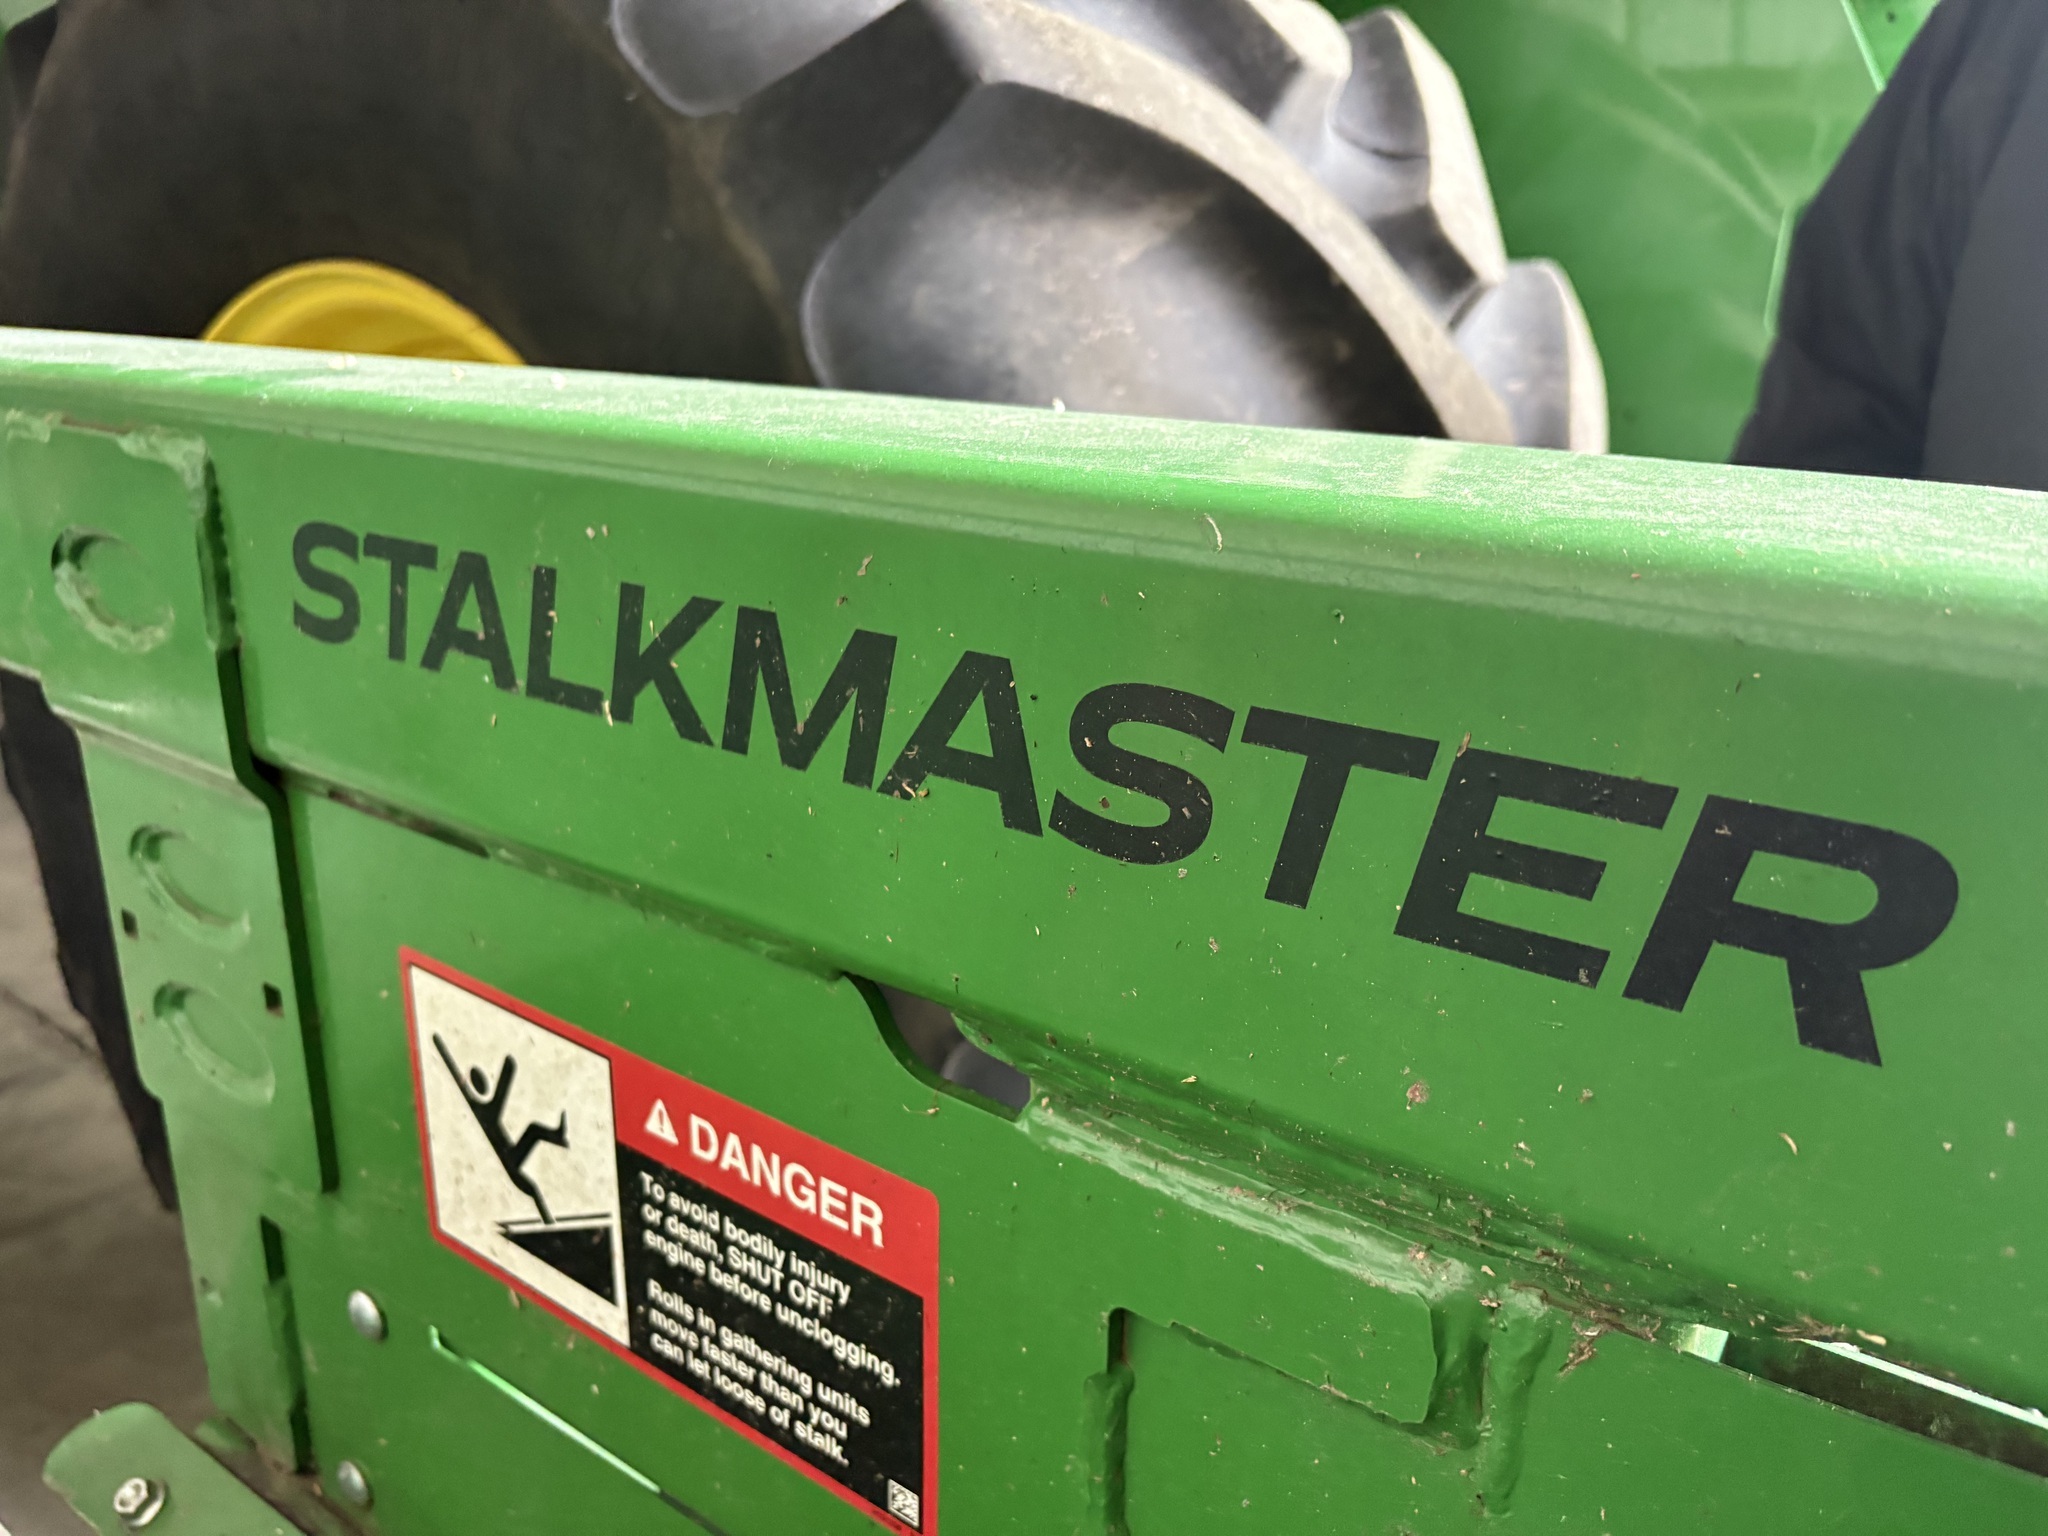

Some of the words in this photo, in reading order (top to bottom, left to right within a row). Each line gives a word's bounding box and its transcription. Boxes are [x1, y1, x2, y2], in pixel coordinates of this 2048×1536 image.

[292, 522, 1960, 1066] STALKMASTER
[640, 1171, 665, 1202] To
[669, 1188, 719, 1232] avoid
[725, 1216, 786, 1268] bodily
[790, 1251, 851, 1308] injury
[689, 1113, 884, 1248] DANGER
[641, 1203, 662, 1228] or
[665, 1212, 723, 1264] death,
[728, 1250, 785, 1293] SHUT
[788, 1280, 834, 1318] OFF
[643, 1229, 706, 1277] engine
[709, 1259, 771, 1312] before
[776, 1302, 901, 1388] unclogging.
[647, 1279, 694, 1322] Rolls
[697, 1307, 717, 1336] in
[720, 1325, 813, 1396] gathering
[817, 1377, 871, 1426] units
[649, 1308, 699, 1349] move
[702, 1331, 756, 1383] faster
[759, 1364, 805, 1412] than
[808, 1402, 848, 1438] you
[650, 1333, 684, 1363] can
[686, 1348, 712, 1382] let
[713, 1365, 766, 1414] loose
[769, 1400, 791, 1430] of
[795, 1422, 850, 1467] stalk.
